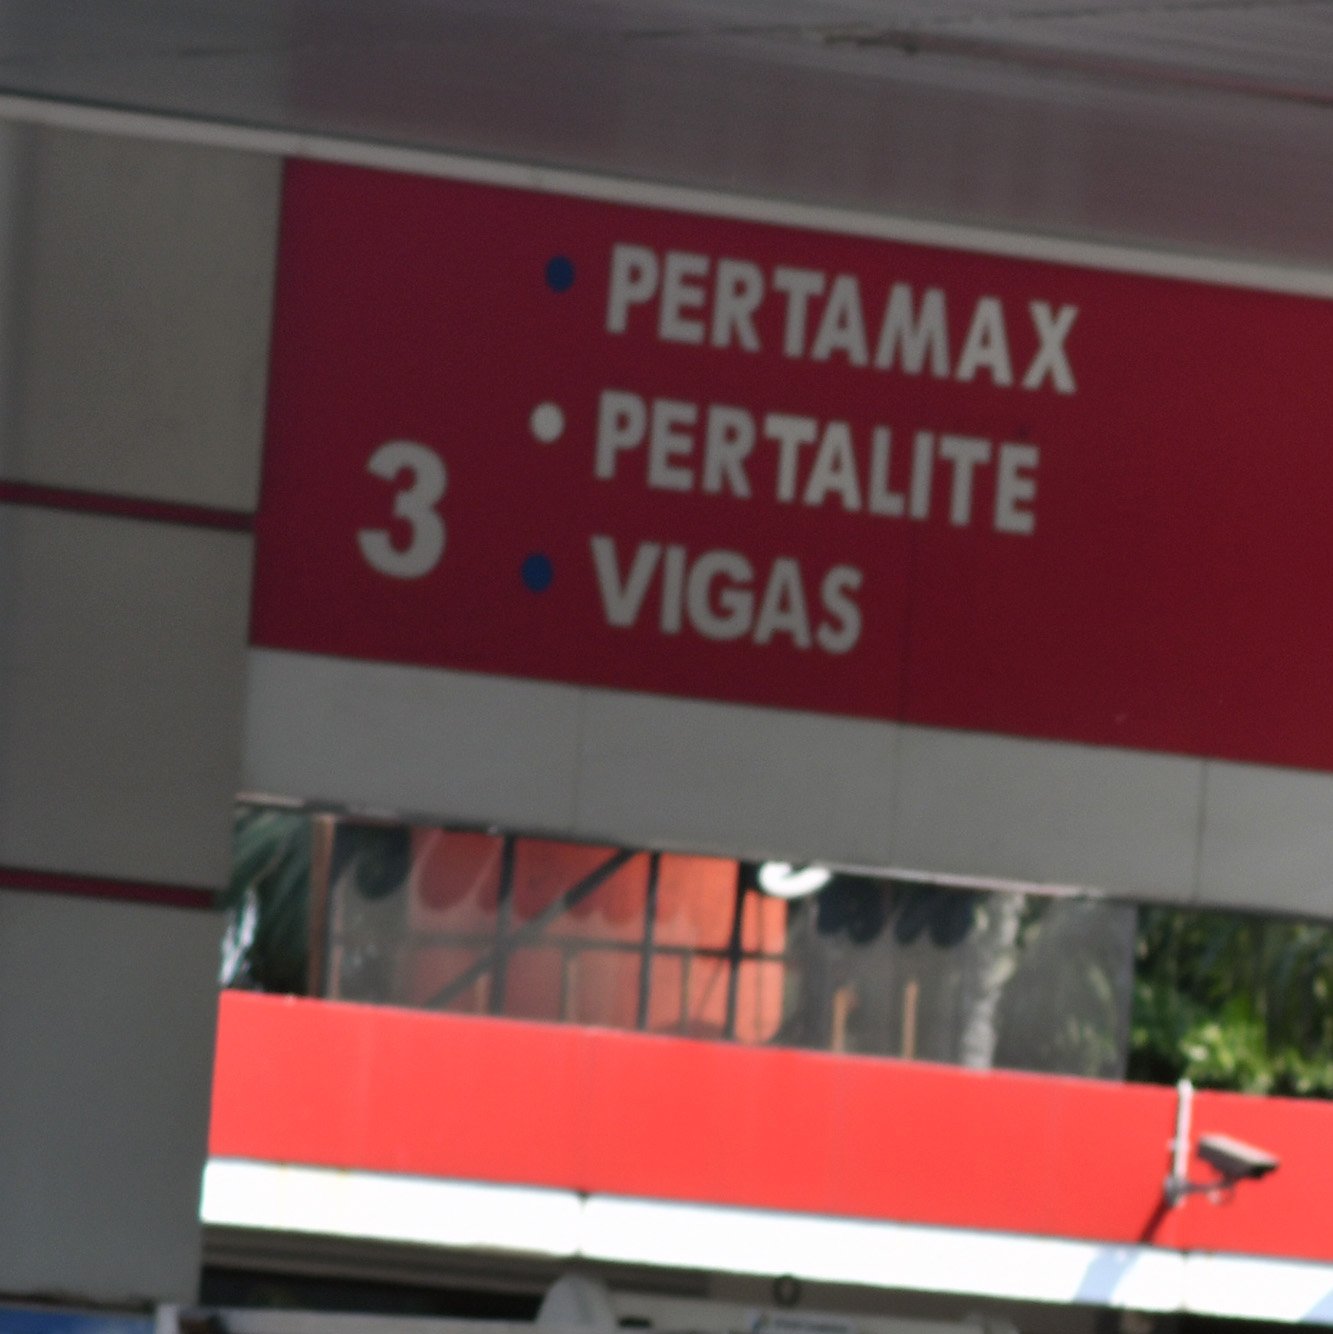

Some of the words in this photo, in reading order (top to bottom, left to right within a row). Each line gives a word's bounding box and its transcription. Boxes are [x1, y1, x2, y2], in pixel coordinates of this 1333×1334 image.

[605, 243, 1080, 395] PERTAMAX
[356, 439, 450, 581] 3
[593, 389, 1041, 537] PERTALITE
[590, 534, 865, 656] VIGAS
